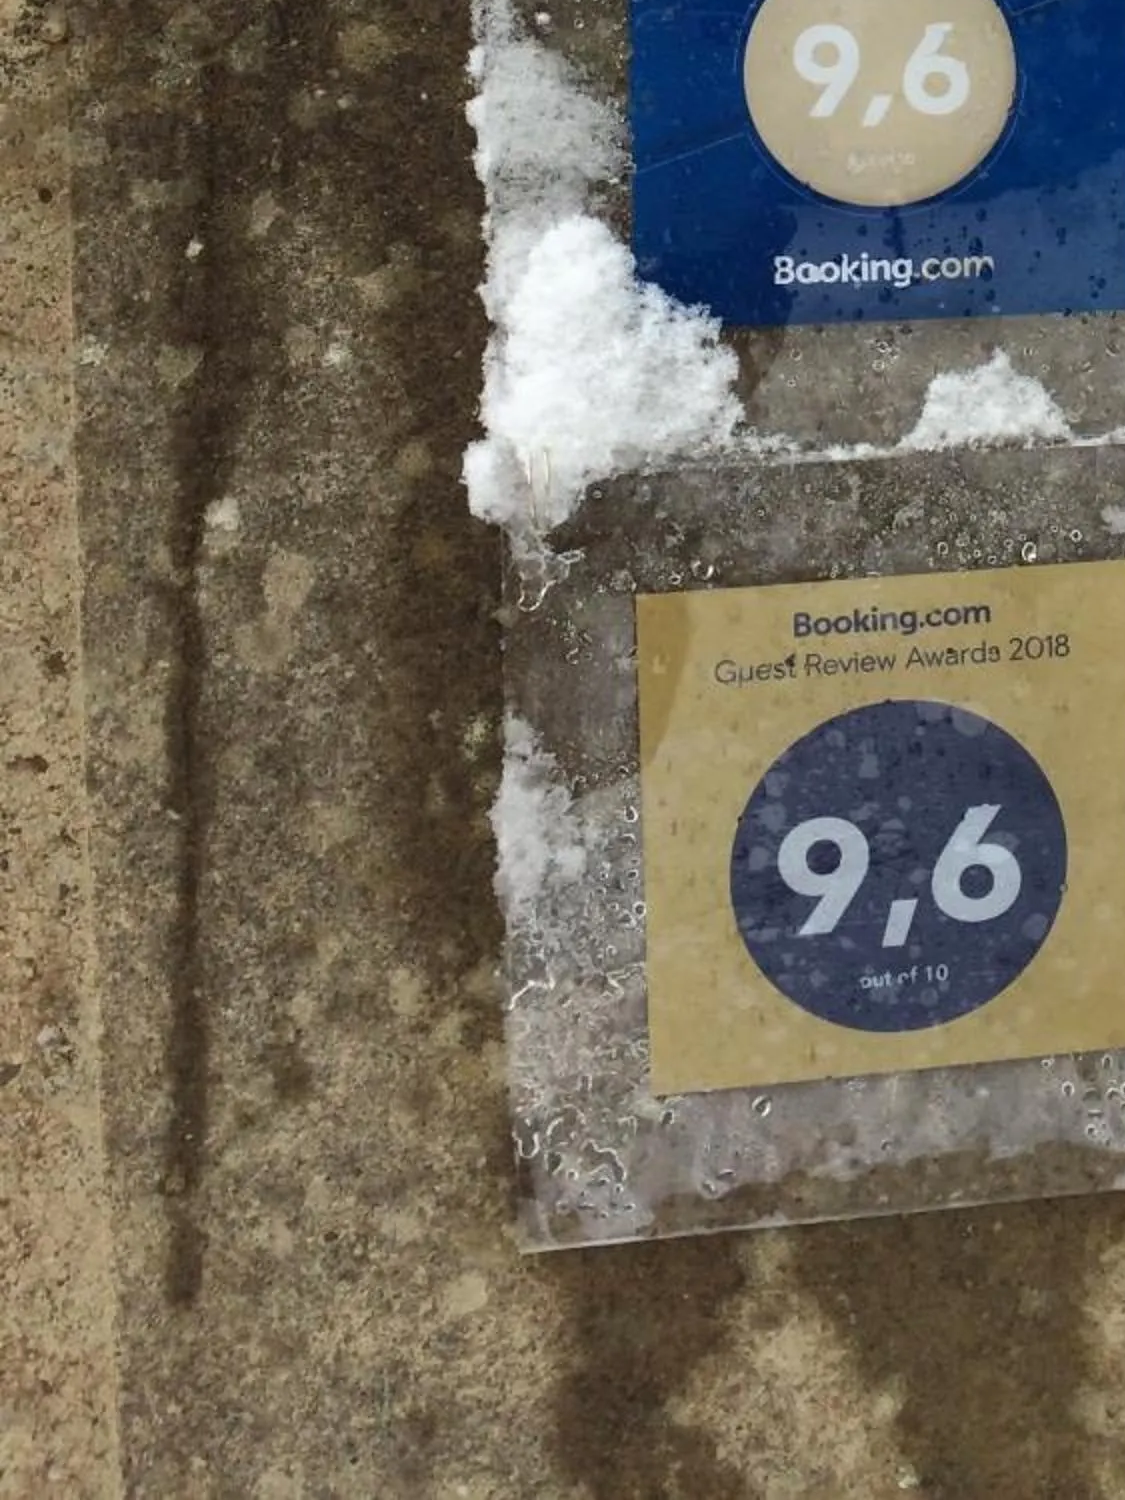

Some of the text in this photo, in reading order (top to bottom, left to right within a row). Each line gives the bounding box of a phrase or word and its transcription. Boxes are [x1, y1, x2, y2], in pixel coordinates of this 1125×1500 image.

[793, 21, 971, 128] 9,6
[773, 251, 995, 288] Booking.com
[793, 603, 991, 638] Booking.com
[713, 633, 1071, 688] Guest Review Awards 2018
[777, 803, 1022, 948] 9,6
[860, 971, 892, 989] out
[925, 963, 950, 982] 10
